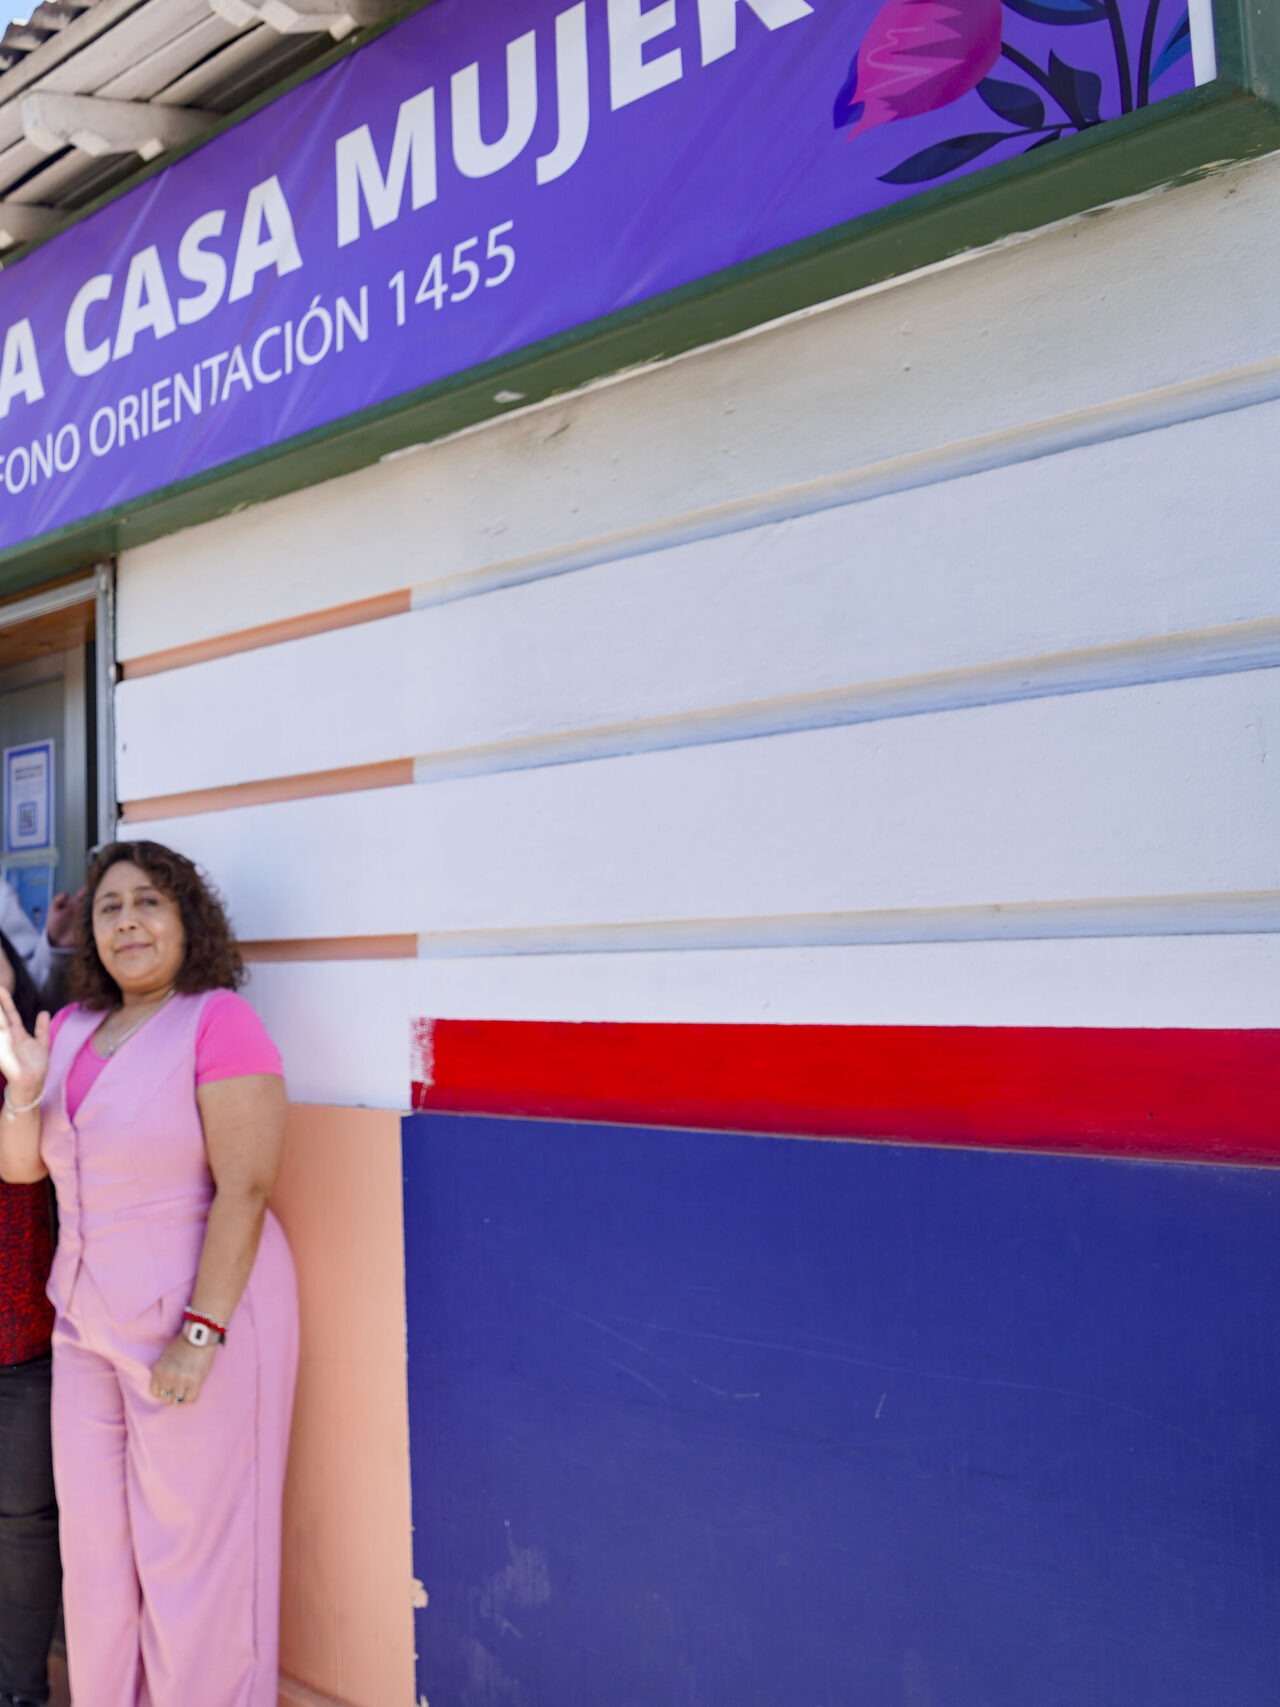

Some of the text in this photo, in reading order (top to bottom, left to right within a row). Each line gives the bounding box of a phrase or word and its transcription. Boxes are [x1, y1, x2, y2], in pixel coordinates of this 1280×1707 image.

[64, 174, 303, 378] CASA
[88, 294, 370, 457] ORIENTACIÓN
[388, 220, 516, 326] 1455
